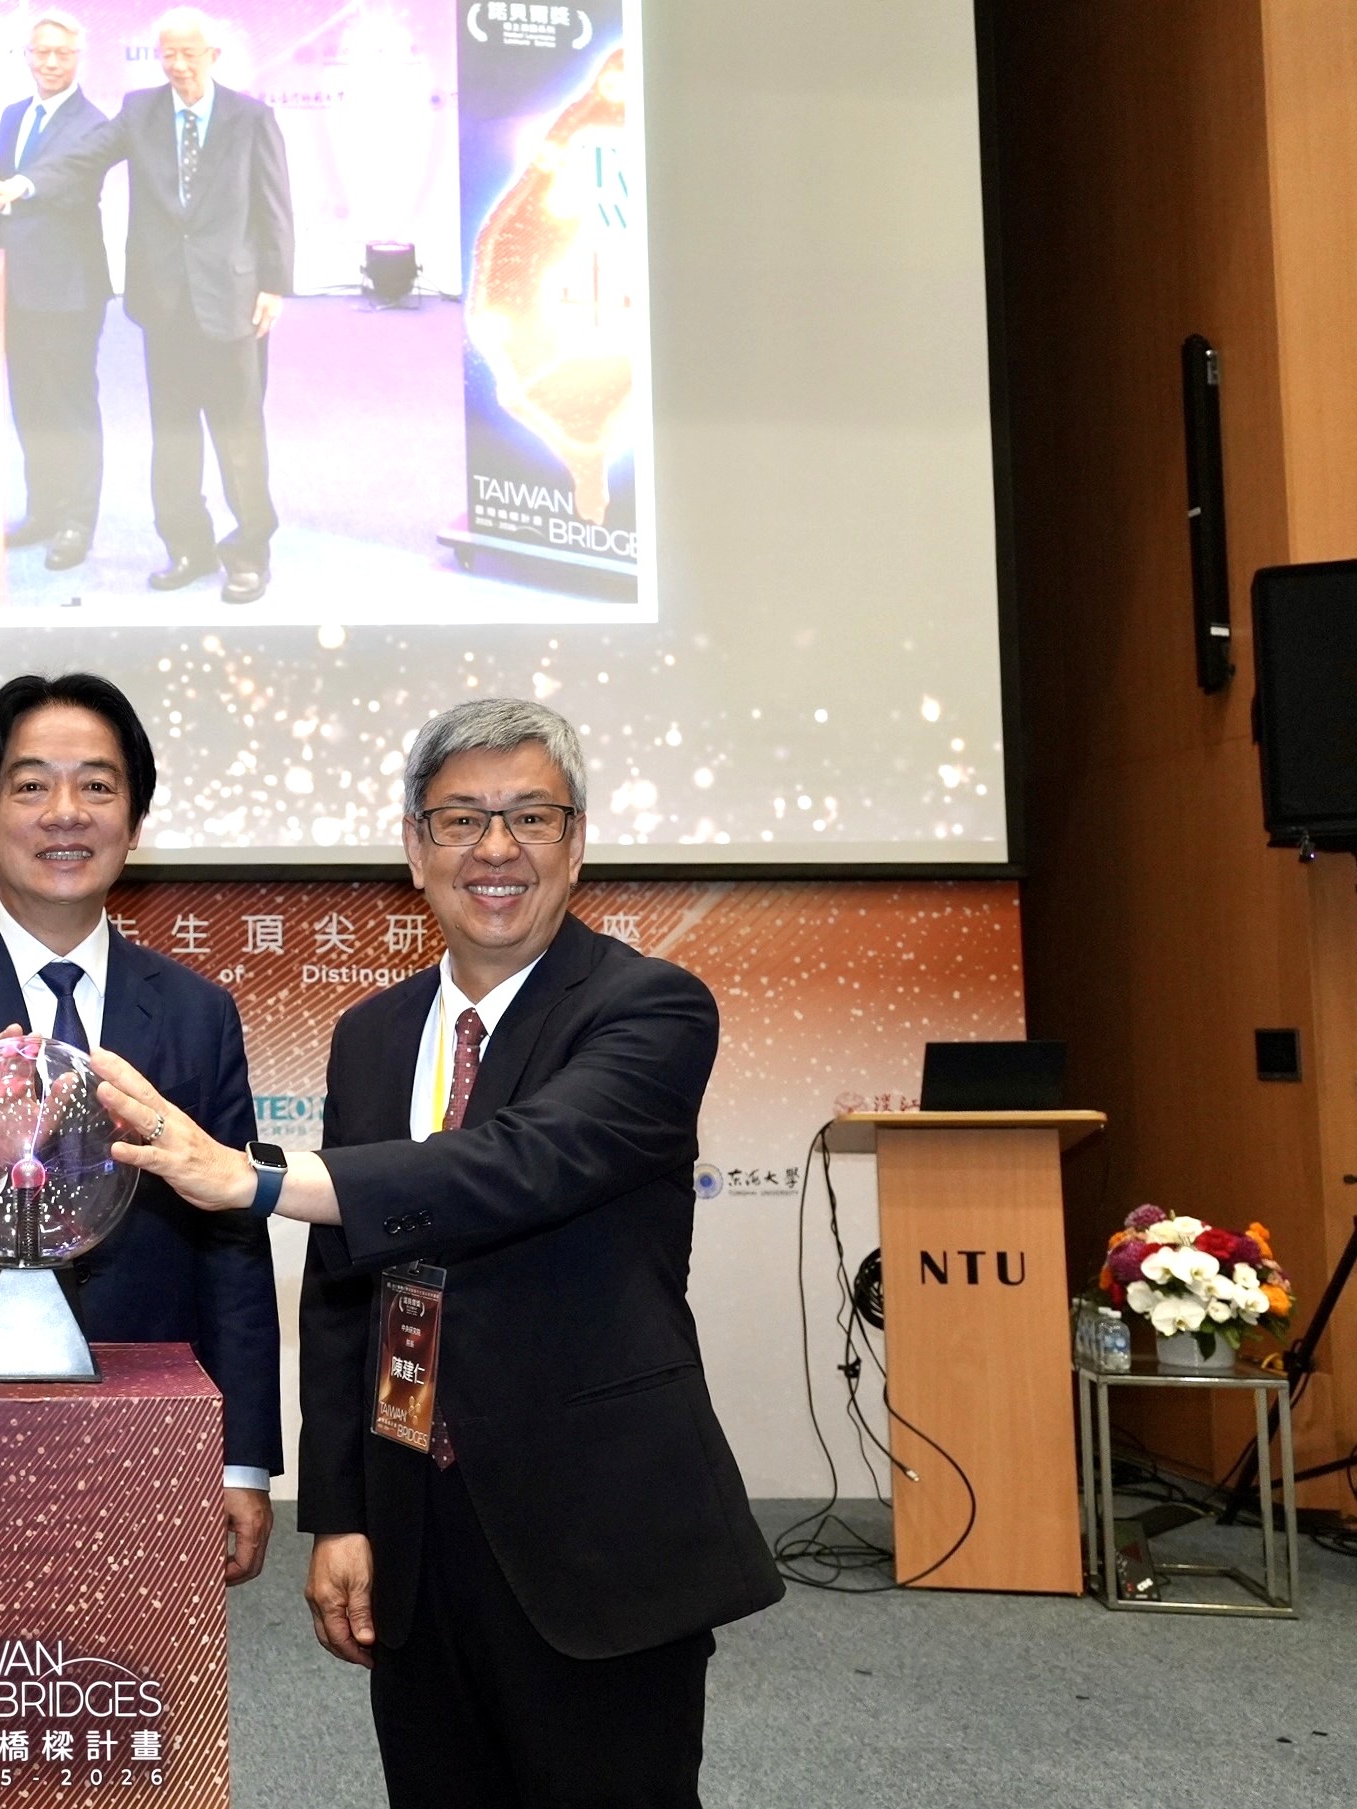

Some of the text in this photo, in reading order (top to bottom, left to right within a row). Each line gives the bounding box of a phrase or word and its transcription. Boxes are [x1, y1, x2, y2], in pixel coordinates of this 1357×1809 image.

[474, 475, 573, 515] TAIWAN
[219, 964, 244, 983] of
[920, 1250, 1025, 1286] NTU
[391, 1356, 425, 1384] 陳建仁
